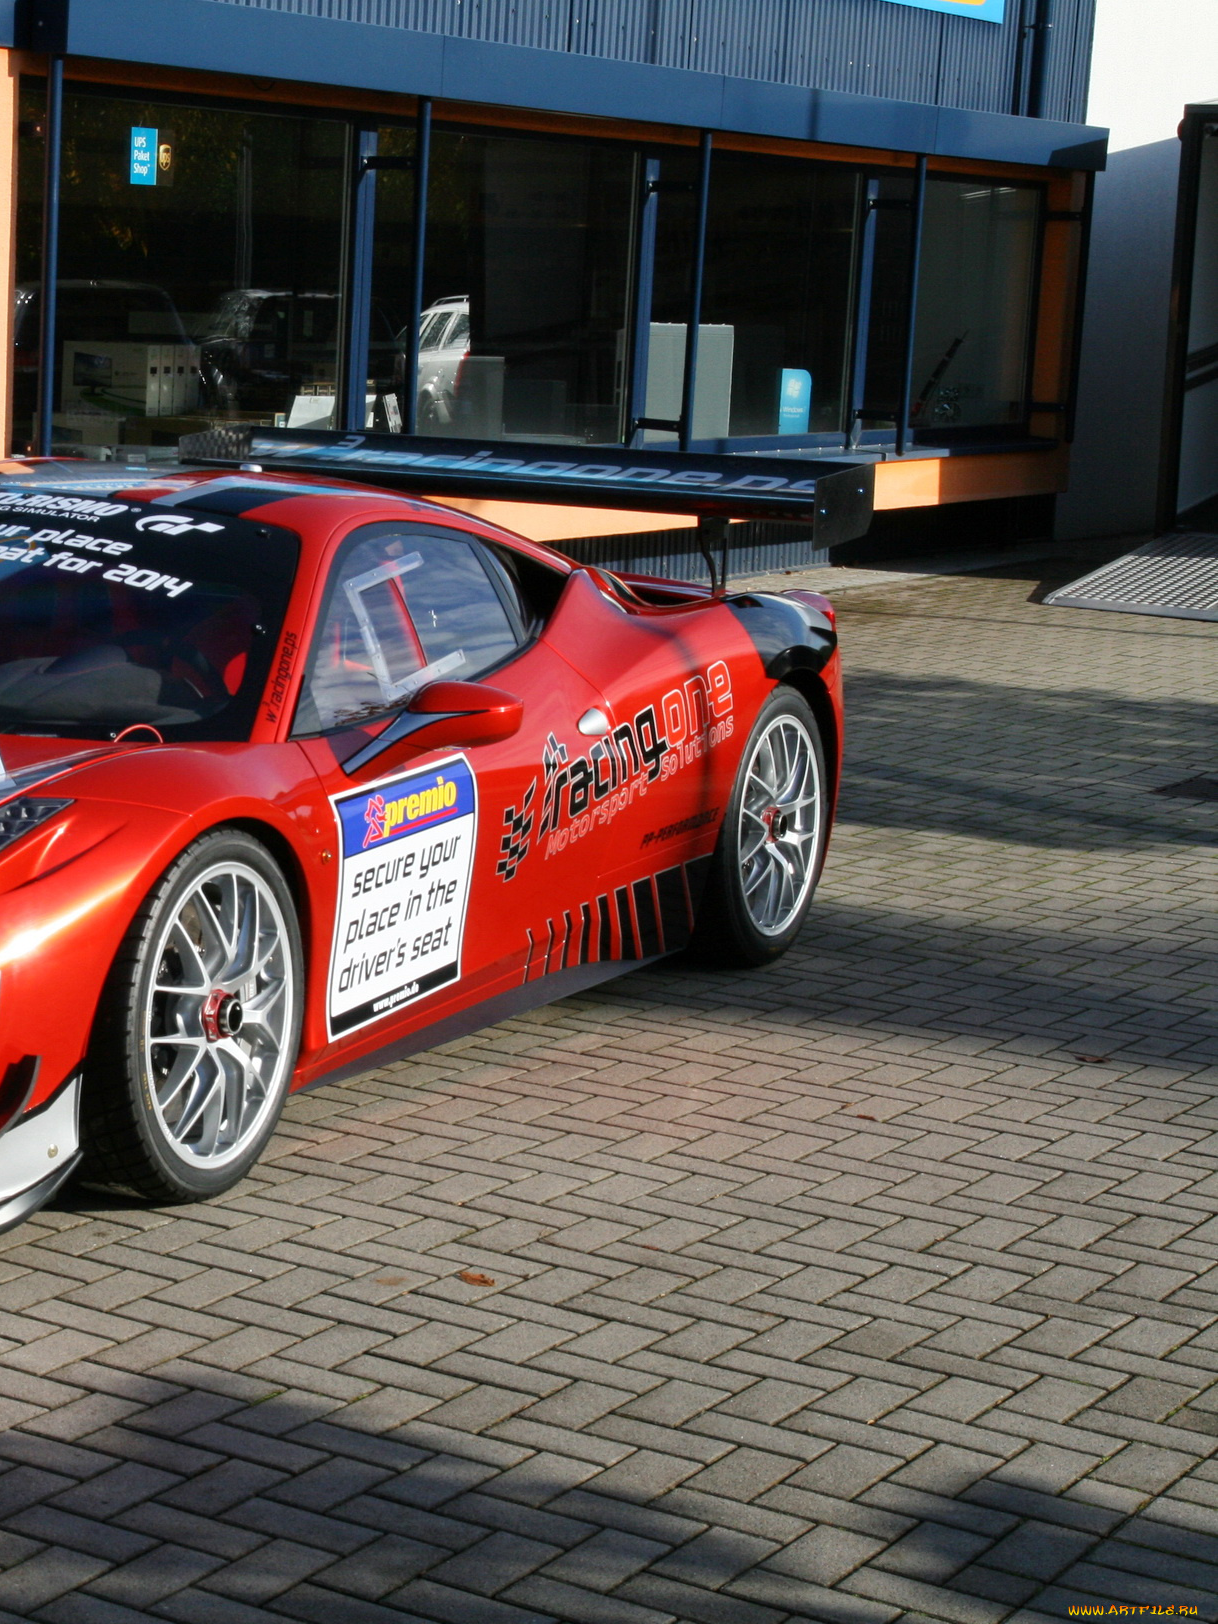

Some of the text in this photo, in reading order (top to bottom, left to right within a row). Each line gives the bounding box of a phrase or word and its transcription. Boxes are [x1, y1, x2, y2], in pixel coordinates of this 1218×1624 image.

[133, 149, 150, 161] Paket
[134, 136, 147, 148] UPS
[12, 506, 101, 523] SIMULATOR
[25, 529, 133, 555] place
[43, 552, 103, 573] for
[102, 563, 193, 598] 2014
[382, 775, 458, 838] premio
[544, 771, 649, 860] Motorsport
[351, 834, 462, 898] secure your
[344, 878, 458, 954] place in the
[338, 916, 453, 993] driver's seat
[373, 981, 420, 1012] www.premio.de
